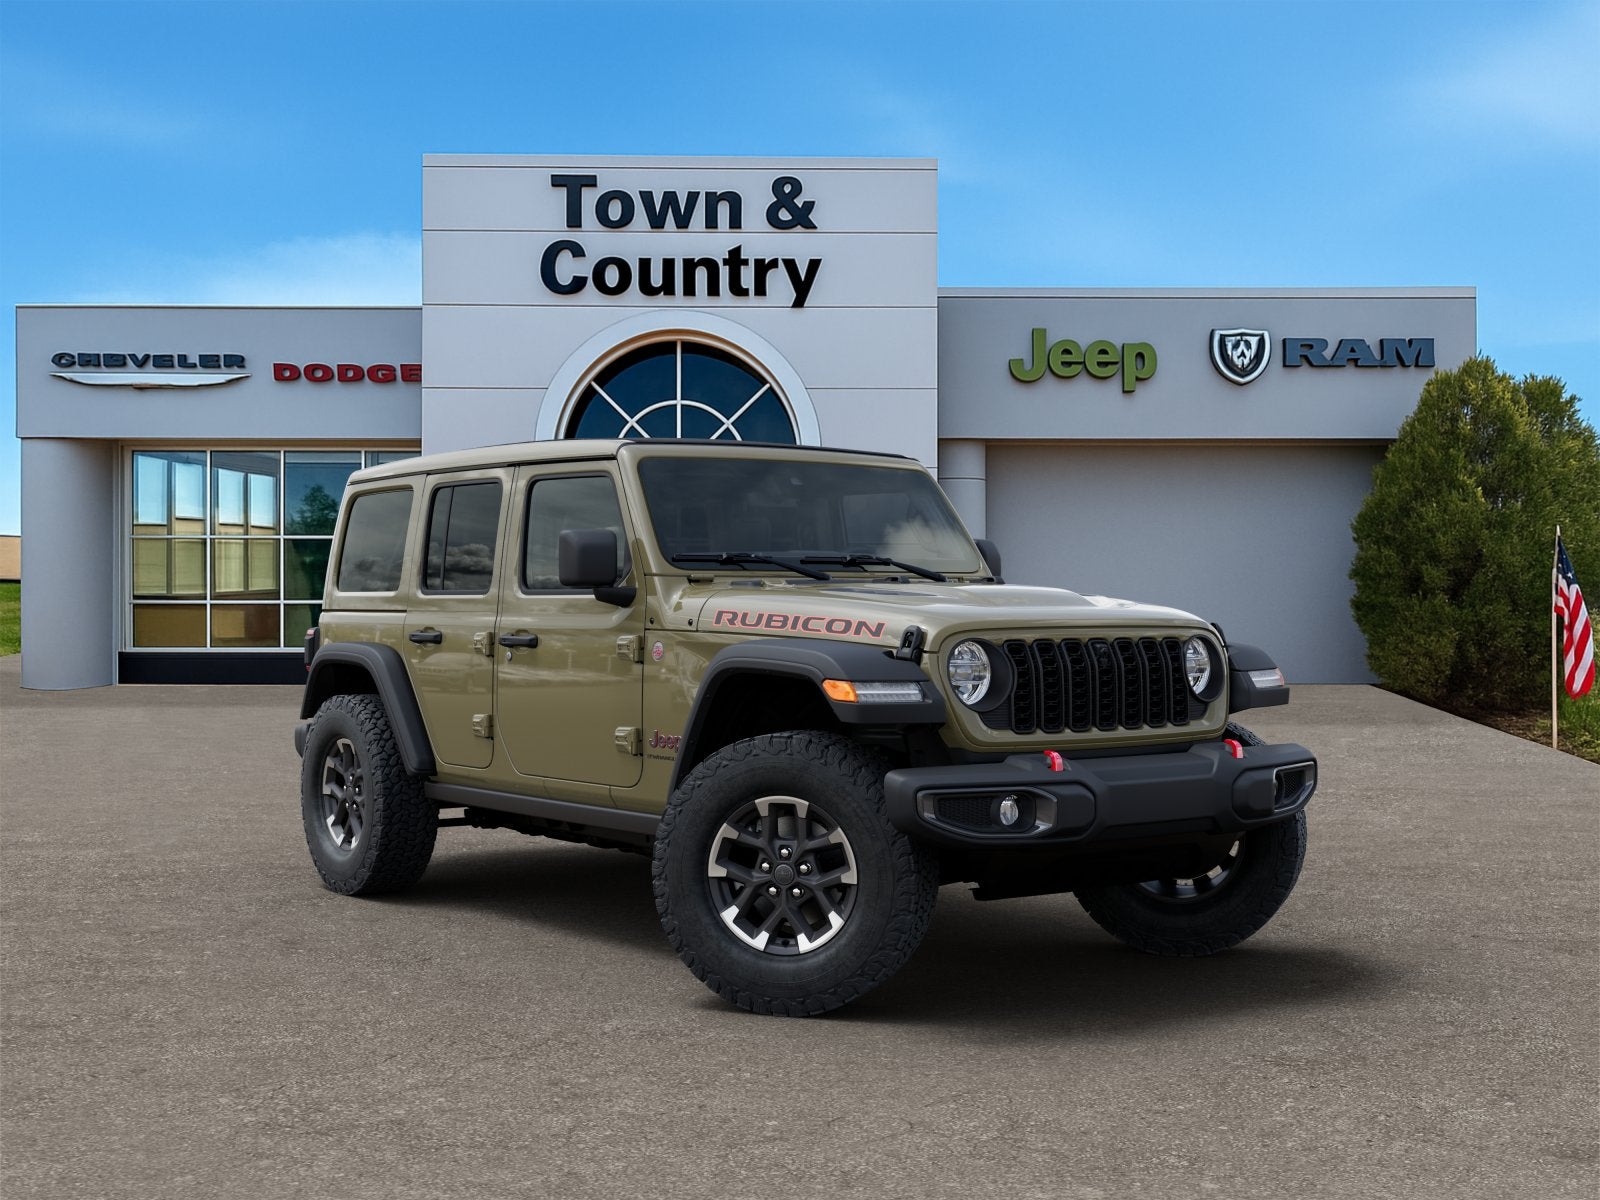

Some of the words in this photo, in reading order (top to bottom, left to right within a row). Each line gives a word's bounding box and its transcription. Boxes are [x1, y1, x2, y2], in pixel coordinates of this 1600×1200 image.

[550, 173, 743, 230] Town
[765, 175, 818, 230] &
[539, 239, 823, 308] Country
[272, 362, 423, 384] DODGE
[1008, 327, 1158, 393] Jeep
[1281, 336, 1436, 368] RAM
[713, 608, 887, 639] RUBICON
